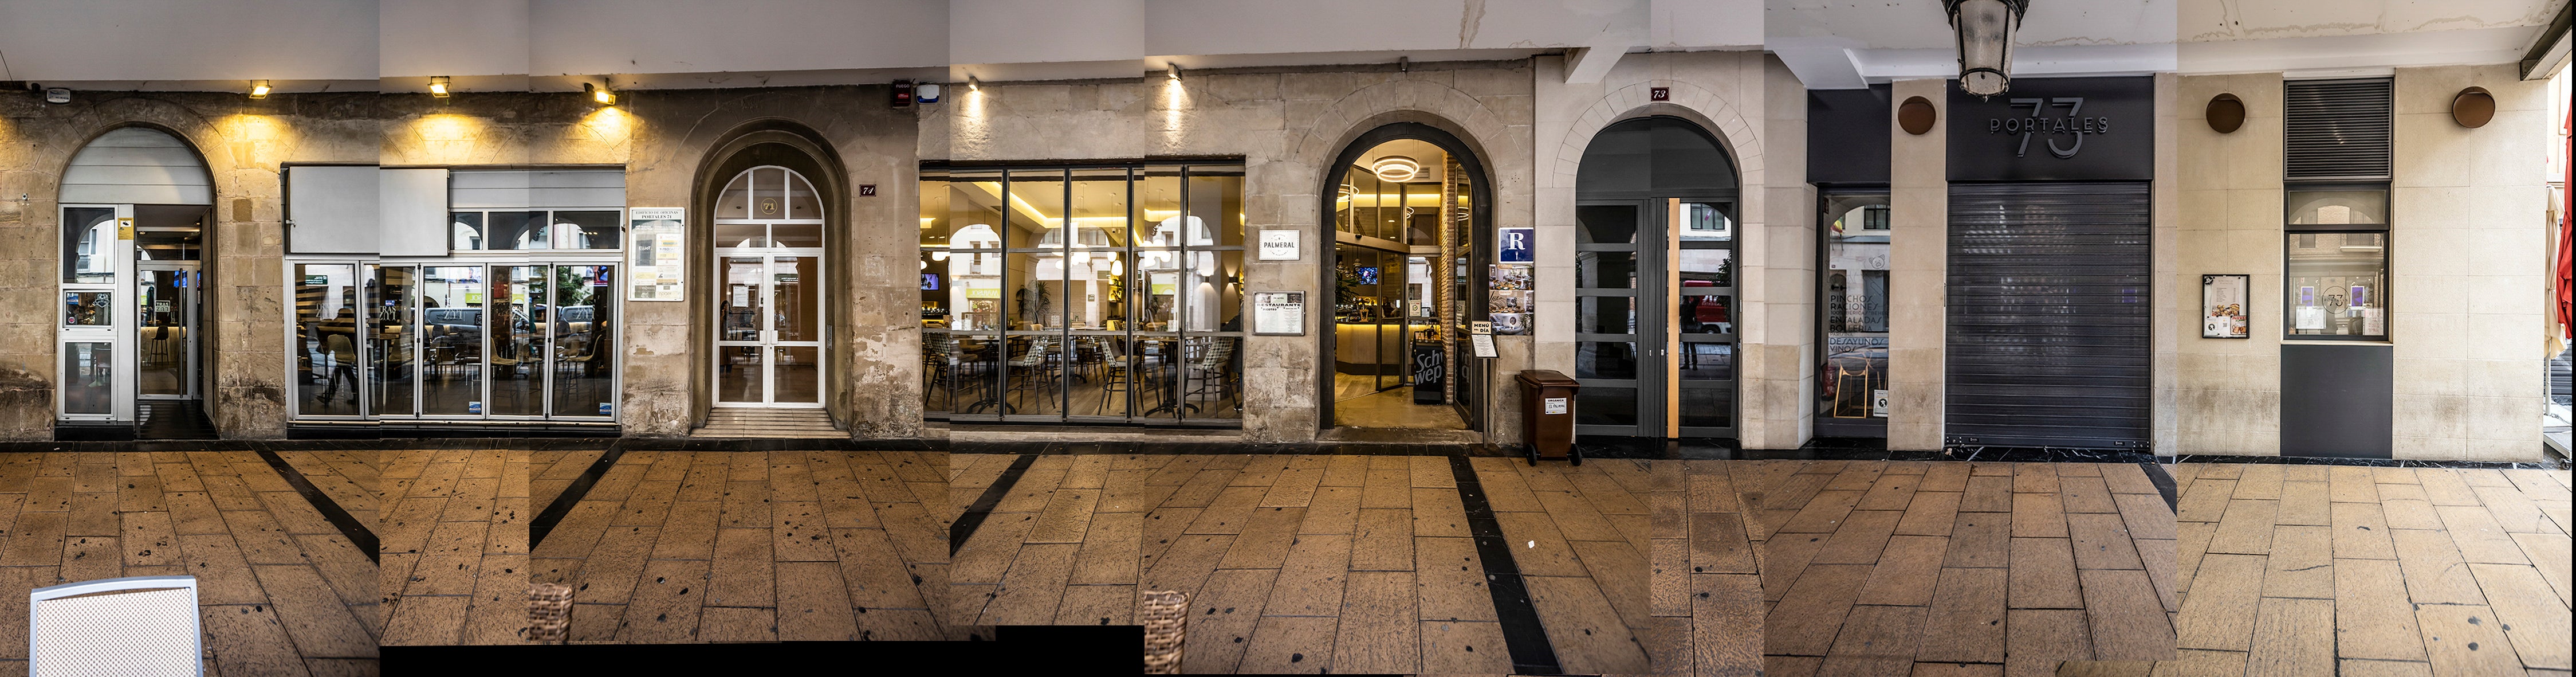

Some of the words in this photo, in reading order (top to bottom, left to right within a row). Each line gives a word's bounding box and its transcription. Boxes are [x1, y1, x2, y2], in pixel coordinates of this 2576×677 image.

[1654, 90, 1666, 99] 73
[1991, 117, 2108, 133] PORTALES
[2010, 97, 2083, 159] 73
[863, 187, 874, 195] 71
[1508, 233, 1525, 250] R
[2328, 294, 2343, 307] 73
